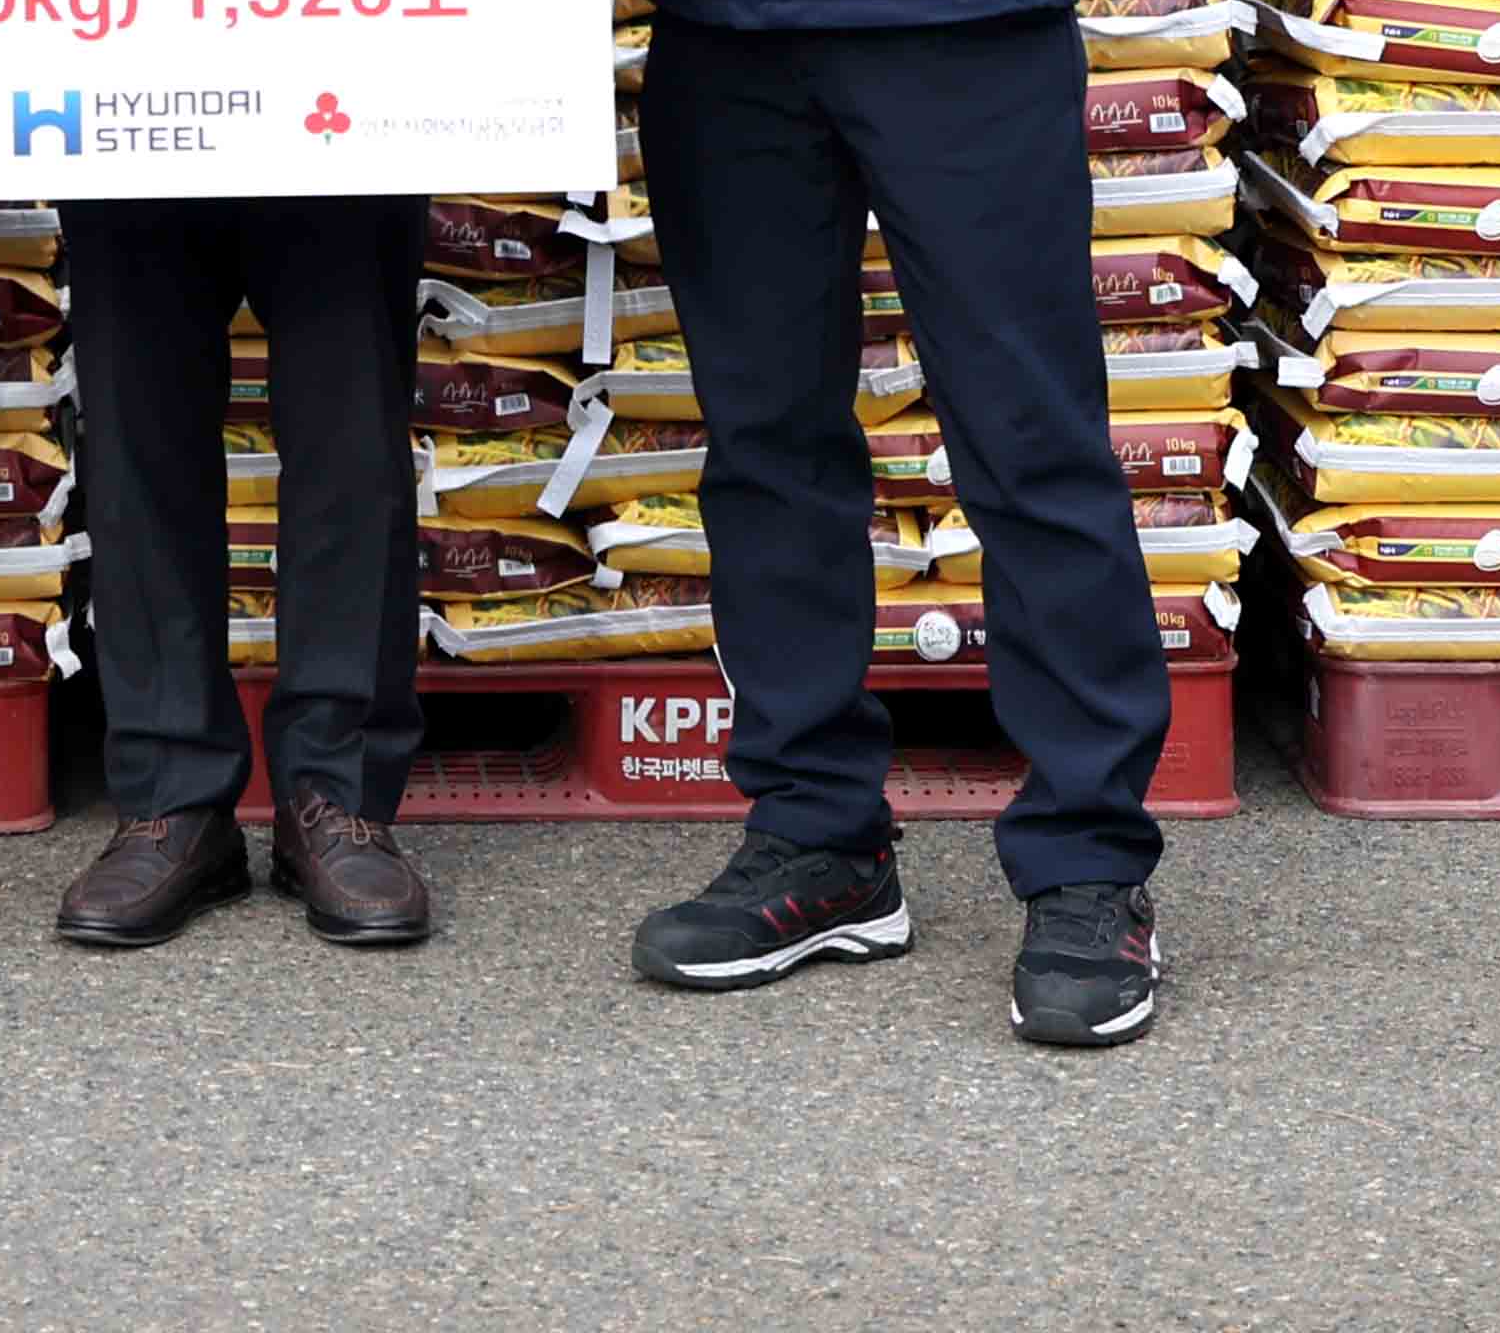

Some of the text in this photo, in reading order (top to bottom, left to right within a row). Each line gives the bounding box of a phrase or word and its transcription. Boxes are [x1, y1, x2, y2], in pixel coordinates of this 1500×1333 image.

[95, 90, 263, 119] HYUNDAI
[96, 124, 216, 152] STEEL
[1165, 437, 1196, 454] 10kg
[619, 696, 735, 744] KPP
[621, 755, 732, 781] 한국파렛트
